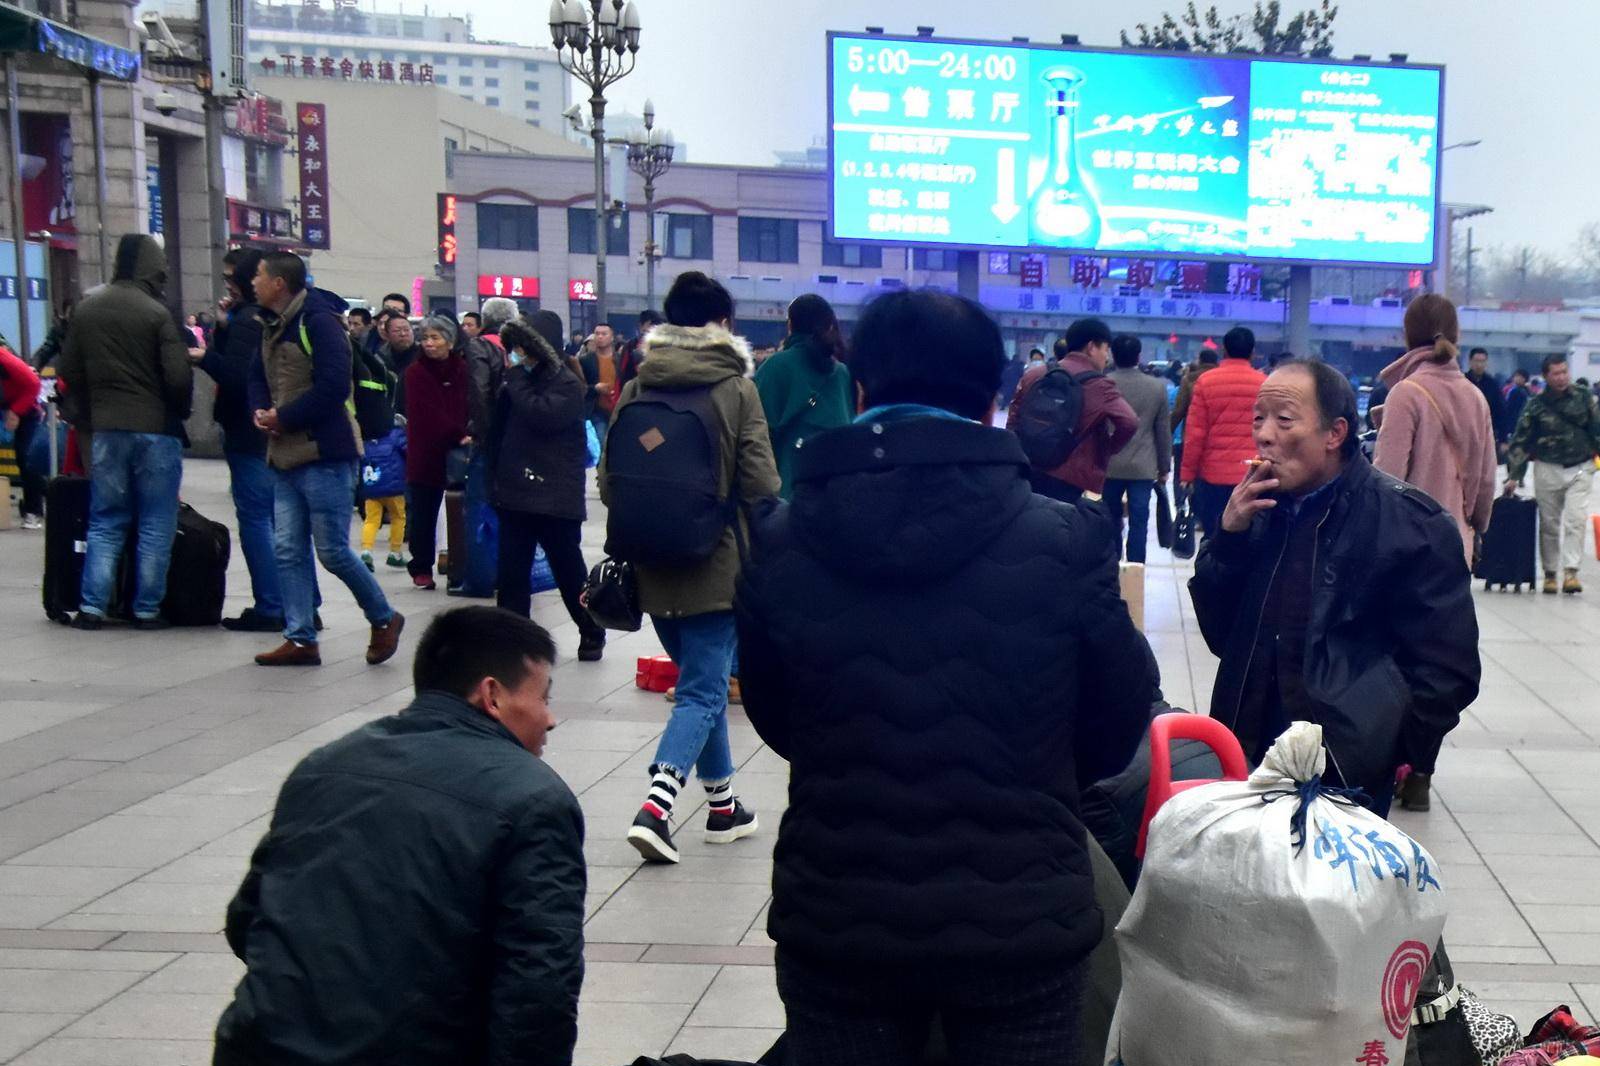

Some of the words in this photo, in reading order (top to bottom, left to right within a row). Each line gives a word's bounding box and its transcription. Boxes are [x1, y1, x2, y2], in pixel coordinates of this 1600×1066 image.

[902, 85, 1021, 123] 售票厅
[304, 134, 323, 220] 永和大王
[1092, 148, 1241, 175] 世界互联网大会
[1019, 257, 1263, 294] 自助取票厅
